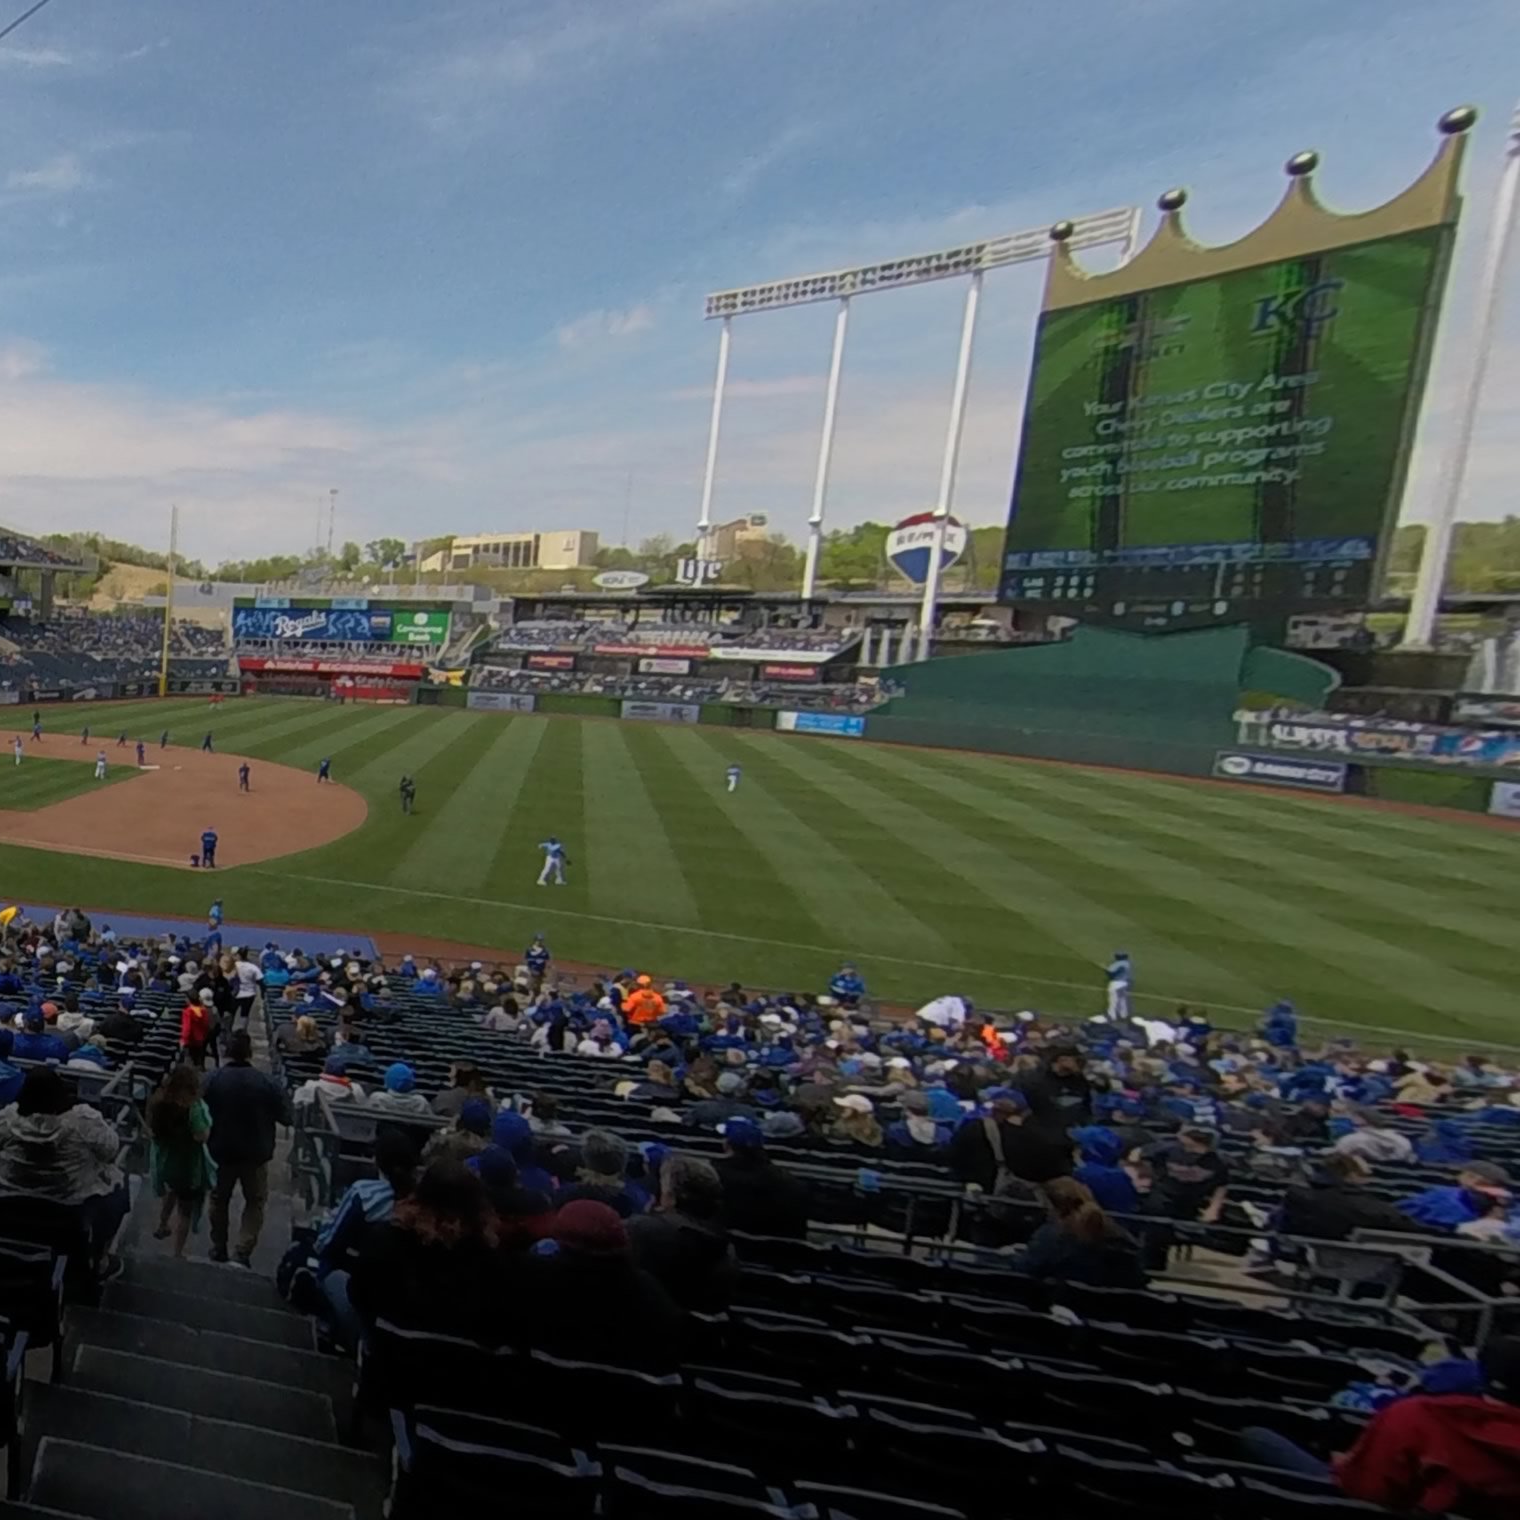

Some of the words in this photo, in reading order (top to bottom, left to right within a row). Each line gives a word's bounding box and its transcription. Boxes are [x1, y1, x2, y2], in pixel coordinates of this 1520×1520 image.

[1083, 400, 1124, 416] Your
[1202, 381, 1253, 401] City
[1257, 372, 1320, 391] Area
[1249, 400, 1291, 416] are
[1167, 432, 1192, 447] to
[1195, 417, 1333, 446] supporting
[1060, 463, 1113, 483] youth
[1202, 441, 1326, 470] programs
[897, 531, 956, 546] RE/MX
[275, 610, 327, 637] Royals
[397, 624, 443, 634] Commerce
